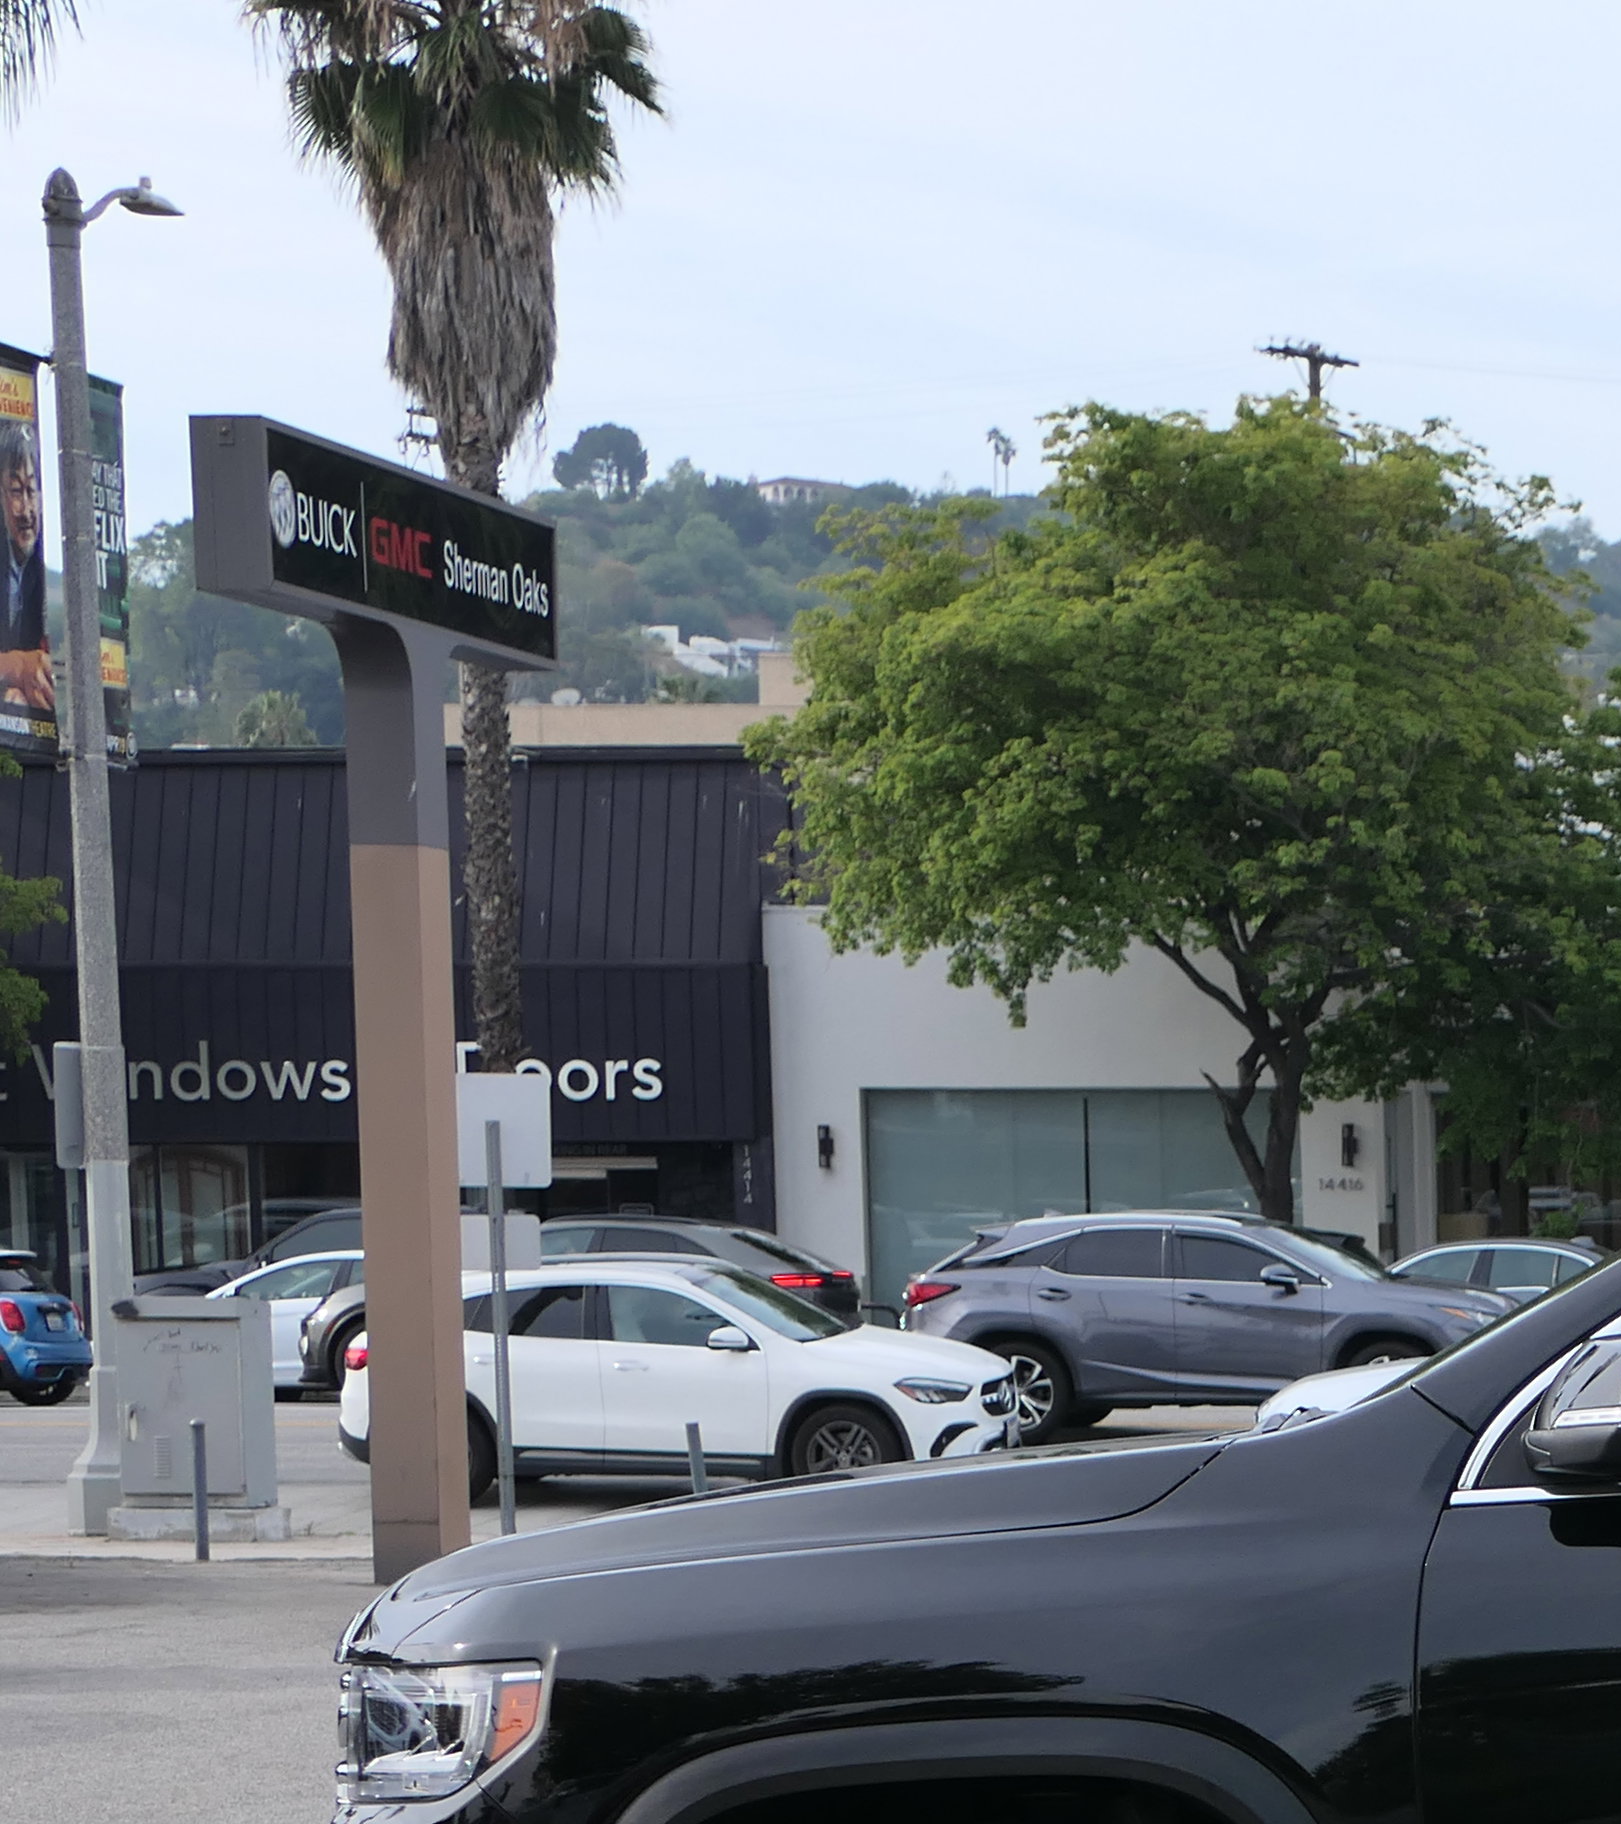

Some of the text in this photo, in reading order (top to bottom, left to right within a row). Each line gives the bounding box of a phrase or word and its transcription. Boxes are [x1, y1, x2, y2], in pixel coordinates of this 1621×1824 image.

[95, 510, 125, 555] FLIX
[297, 492, 549, 618] BUICK GMC Sherman Oaks
[30, 1040, 352, 1101] ndows
[456, 1041, 663, 1101] ors
